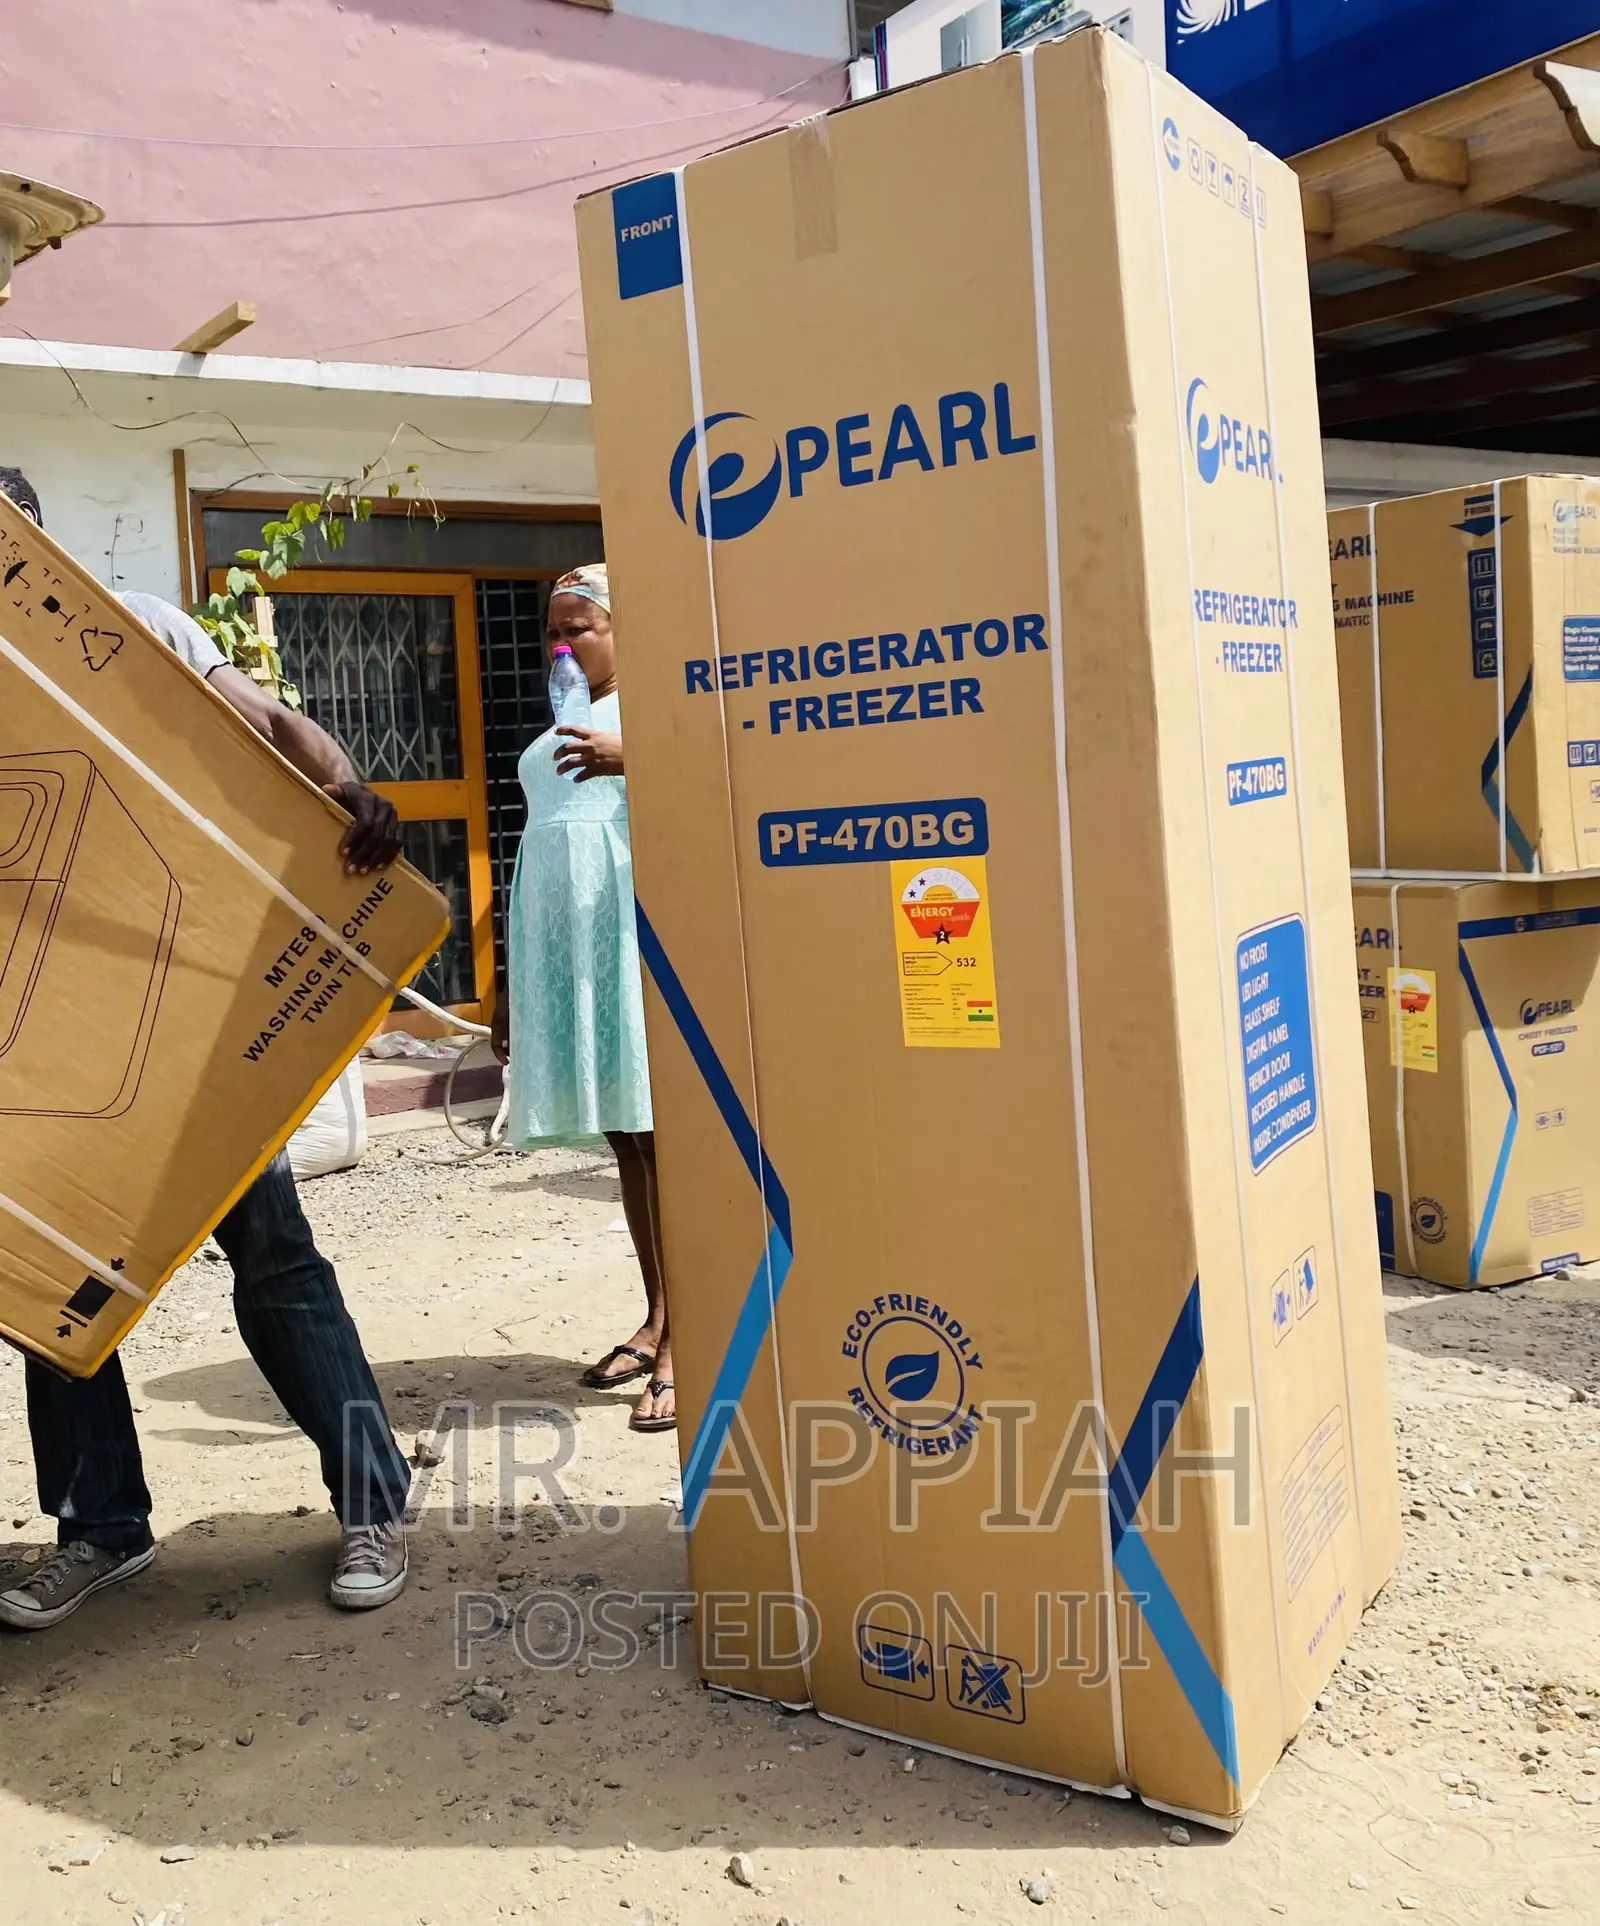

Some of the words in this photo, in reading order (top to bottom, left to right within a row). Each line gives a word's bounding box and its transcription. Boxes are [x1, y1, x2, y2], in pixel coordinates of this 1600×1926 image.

[620, 214, 674, 243] FRONT
[786, 382, 1036, 498] PEARL
[1219, 413, 1283, 484] PEAR
[1194, 588, 1298, 628] REFRIGERATOR
[684, 613, 1049, 695] REFRIGERATOR
[1222, 640, 1283, 672] FREEZER
[769, 677, 985, 735] FREEZER
[1228, 762, 1284, 800] PF-470BG
[769, 811, 976, 856] PF-470BG
[910, 905, 954, 921] ENERGY
[939, 931, 946, 939] 2
[264, 914, 326, 989] MTE8
[956, 957, 977, 967] 532
[1240, 951, 1249, 972] NO
[1249, 942, 1268, 967] FROST
[300, 978, 343, 1024] TWIN
[1242, 981, 1251, 1003] LED
[1251, 972, 1269, 997] LIGHT
[1538, 999, 1575, 1018] PEARL
[243, 968, 322, 1062] WASHING
[1244, 1005, 1262, 1033] GLASS
[1261, 996, 1280, 1022] SHELF
[1246, 1033, 1268, 1064] DIGITAL
[1268, 1023, 1289, 1049] PANEL
[1249, 1063, 1271, 1095] FRENCH
[1271, 1051, 1291, 1078] DOOR
[1251, 1090, 1279, 1125] RECESSED
[1279, 1073, 1306, 1103] HANDLE
[1253, 1125, 1272, 1156] INSIDE
[1271, 1099, 1312, 1140] CONDENSER
[842, 1293, 984, 1370] ECO-FRIENDLY
[847, 1386, 984, 1456] REFRIGERANT
